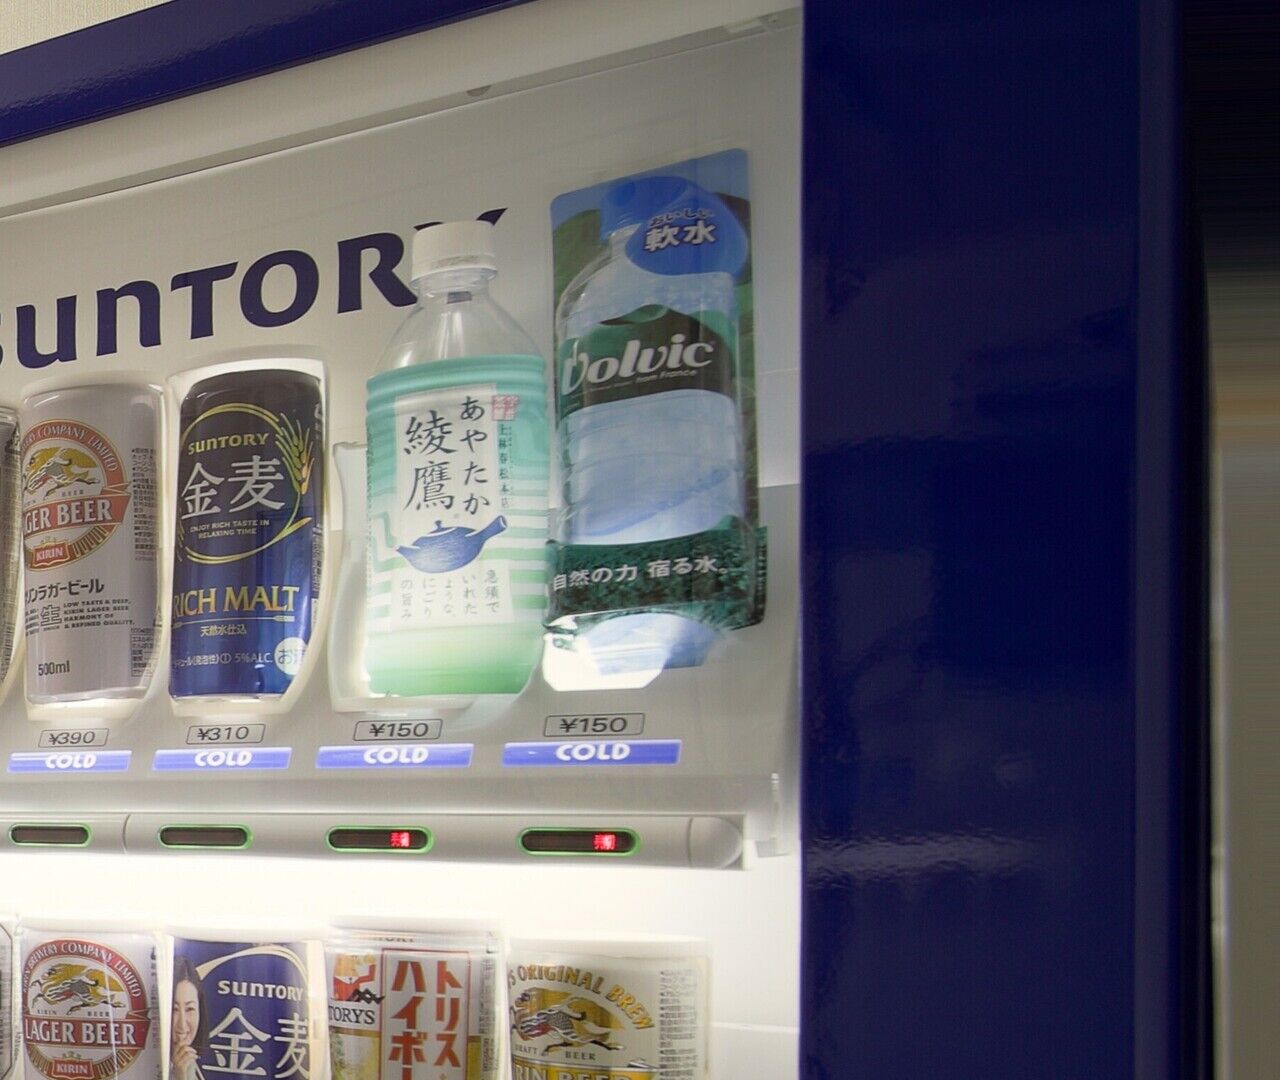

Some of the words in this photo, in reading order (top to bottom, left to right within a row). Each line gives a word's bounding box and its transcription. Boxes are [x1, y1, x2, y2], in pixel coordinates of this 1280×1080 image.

[644, 219, 717, 252] 軟水
[562, 333, 714, 396] Volvic
[660, 369, 699, 379] France
[402, 409, 458, 512] 綾鷹
[459, 396, 490, 515] あやたか
[180, 454, 286, 520] 金麦
[57, 498, 113, 526] BEER
[198, 529, 235, 539] RELAXING
[211, 521, 231, 529] RICH
[232, 519, 258, 527] TASTE
[260, 519, 270, 527] IN
[36, 547, 64, 561] KIRIN
[552, 562, 638, 592] 自然の力
[646, 557, 730, 582] 宿る水。
[173, 587, 217, 620] RICH
[223, 585, 300, 613] MALT
[422, 578, 436, 617] にごり
[462, 572, 478, 615] いれた
[200, 624, 248, 638] 天然水仕込
[38, 660, 70, 676] 500ml
[197, 726, 250, 741] ¥310
[368, 722, 428, 738] ¥150
[559, 716, 628, 733] ¥150
[48, 731, 96, 745] ¥390
[45, 751, 97, 769] COLD
[194, 749, 253, 768] COLD
[363, 746, 429, 764] COLD
[555, 741, 631, 760] COLD
[61, 942, 114, 965] COMPANY
[114, 958, 142, 998] LIMITED
[217, 979, 304, 1000] SUNTORY
[518, 963, 602, 995] ORIGINAL
[605, 984, 656, 1029] BREW
[328, 1004, 377, 1026] TORYS
[433, 960, 463, 1068] トリス
[25, 1019, 76, 1044] LAGER
[81, 1022, 137, 1046] BEER
[202, 1006, 310, 1080] 金麦
[565, 1050, 596, 1061] BEER
[56, 1062, 89, 1074] KIRIN
